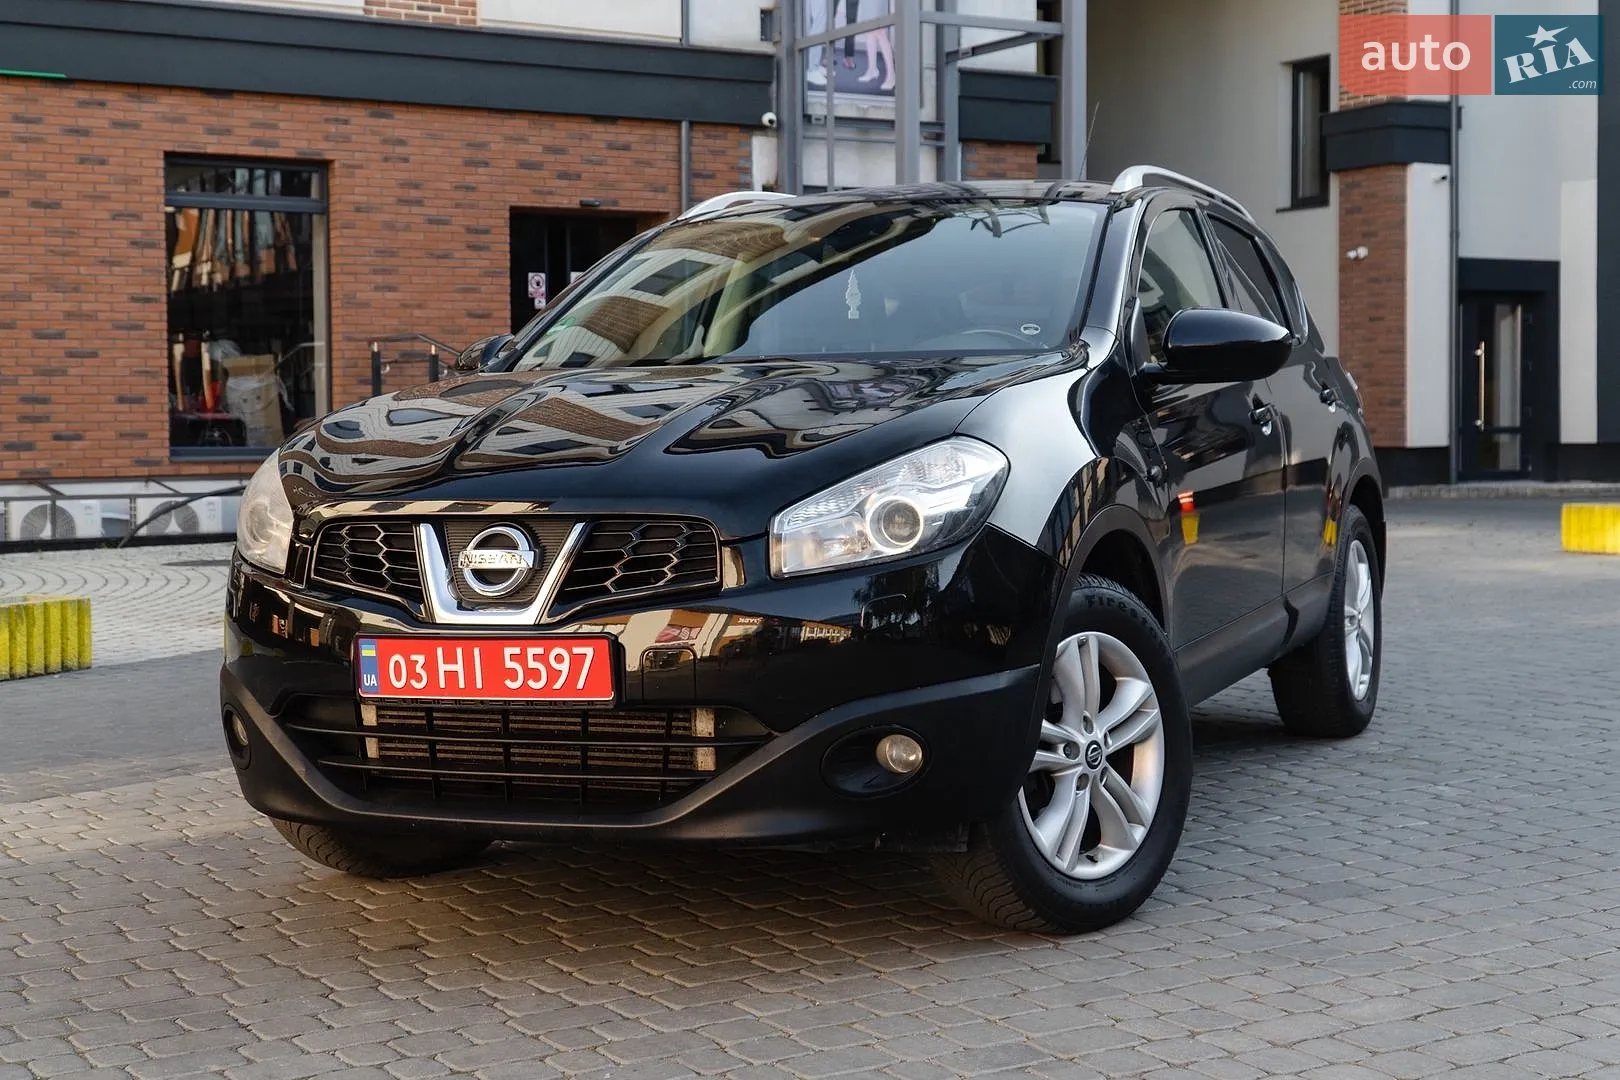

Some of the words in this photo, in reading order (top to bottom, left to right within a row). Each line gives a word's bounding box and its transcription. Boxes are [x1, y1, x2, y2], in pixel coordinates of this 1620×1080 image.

[363, 673, 378, 687] UA
[388, 653, 428, 690] 03
[435, 646, 483, 690] HI
[503, 646, 595, 690] 5597
